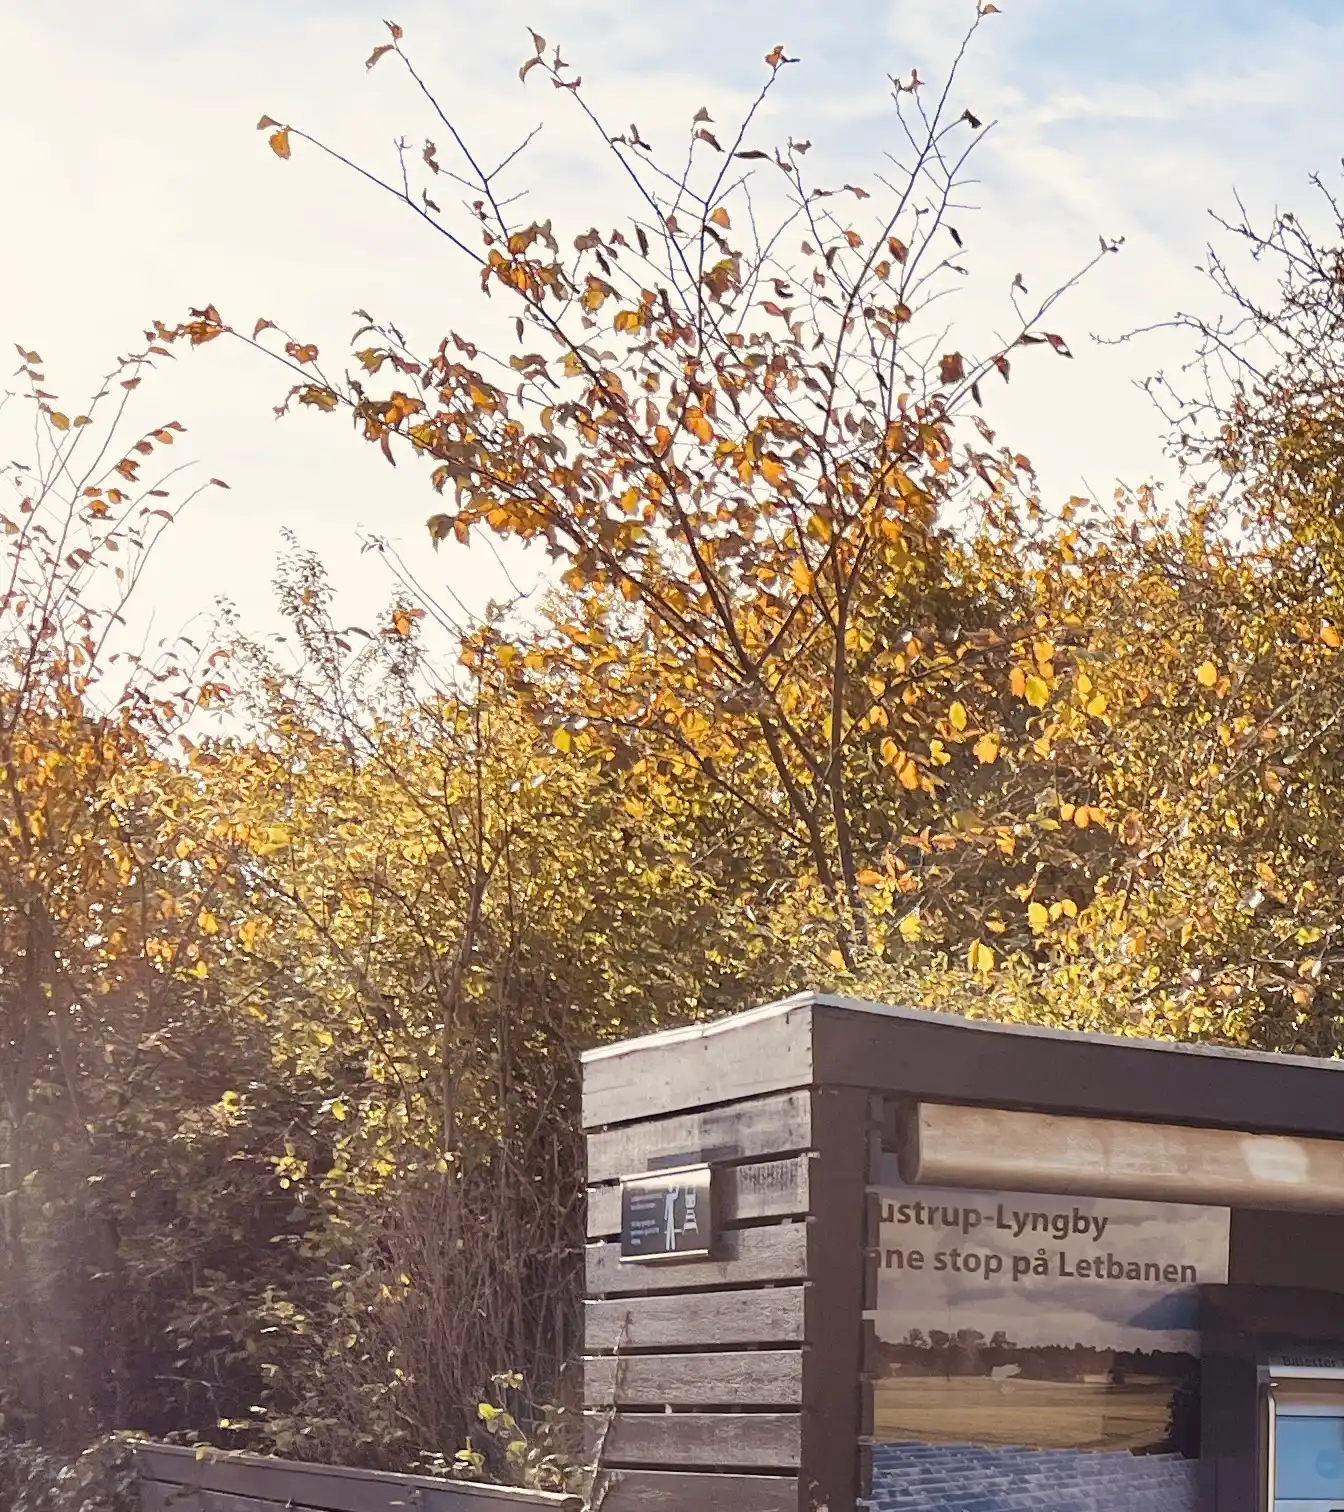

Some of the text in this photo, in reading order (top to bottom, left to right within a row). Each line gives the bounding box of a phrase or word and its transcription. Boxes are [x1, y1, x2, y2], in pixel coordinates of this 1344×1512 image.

[933, 1249, 1003, 1280] stop
[1012, 1248, 1049, 1282] på
[1058, 1251, 1197, 1283] Letbanen
